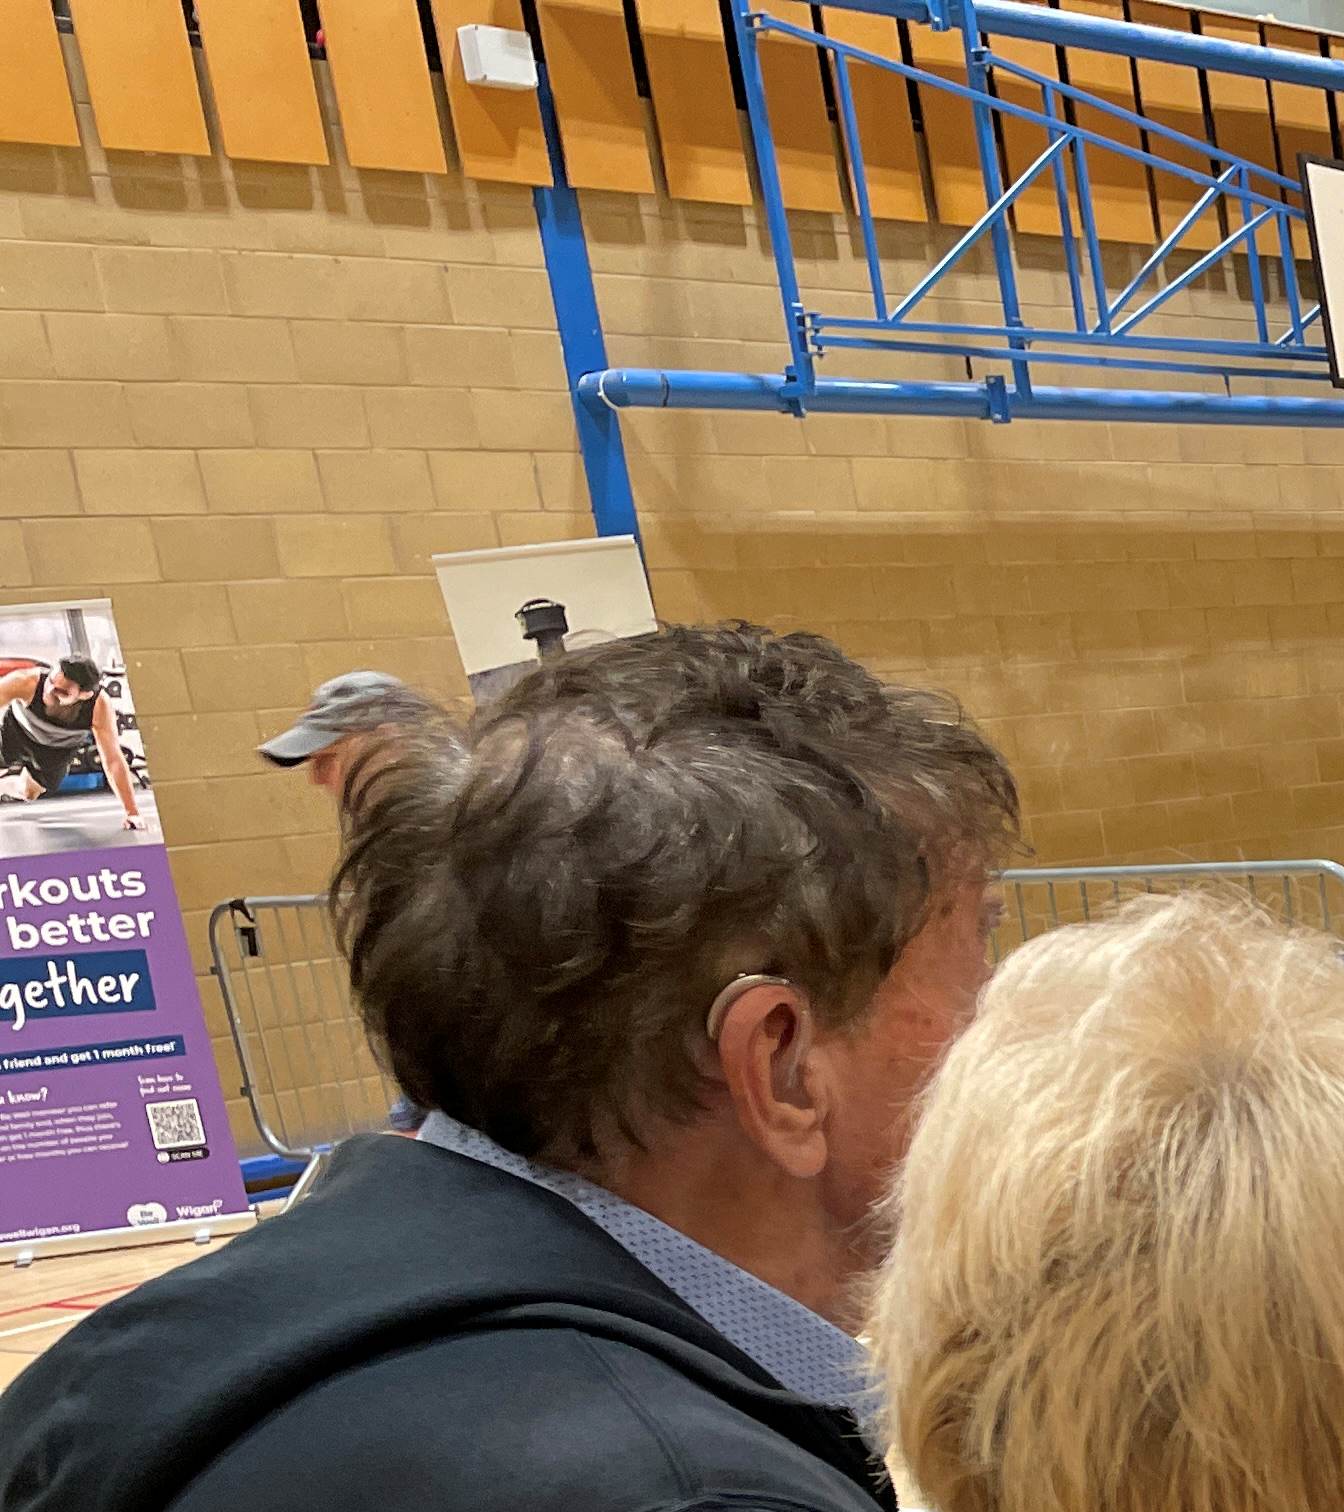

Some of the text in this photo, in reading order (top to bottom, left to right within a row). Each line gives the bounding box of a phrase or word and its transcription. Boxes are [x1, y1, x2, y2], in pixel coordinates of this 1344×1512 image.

[0, 869, 146, 909] rkouts
[6, 911, 154, 949] better
[0, 960, 139, 1031] gether
[4, 1053, 41, 1070] friend
[45, 1053, 68, 1065] and
[71, 1049, 91, 1064] get
[102, 1045, 143, 1059] month
[8, 1087, 48, 1104] know?
[176, 1203, 218, 1217] Wigan
